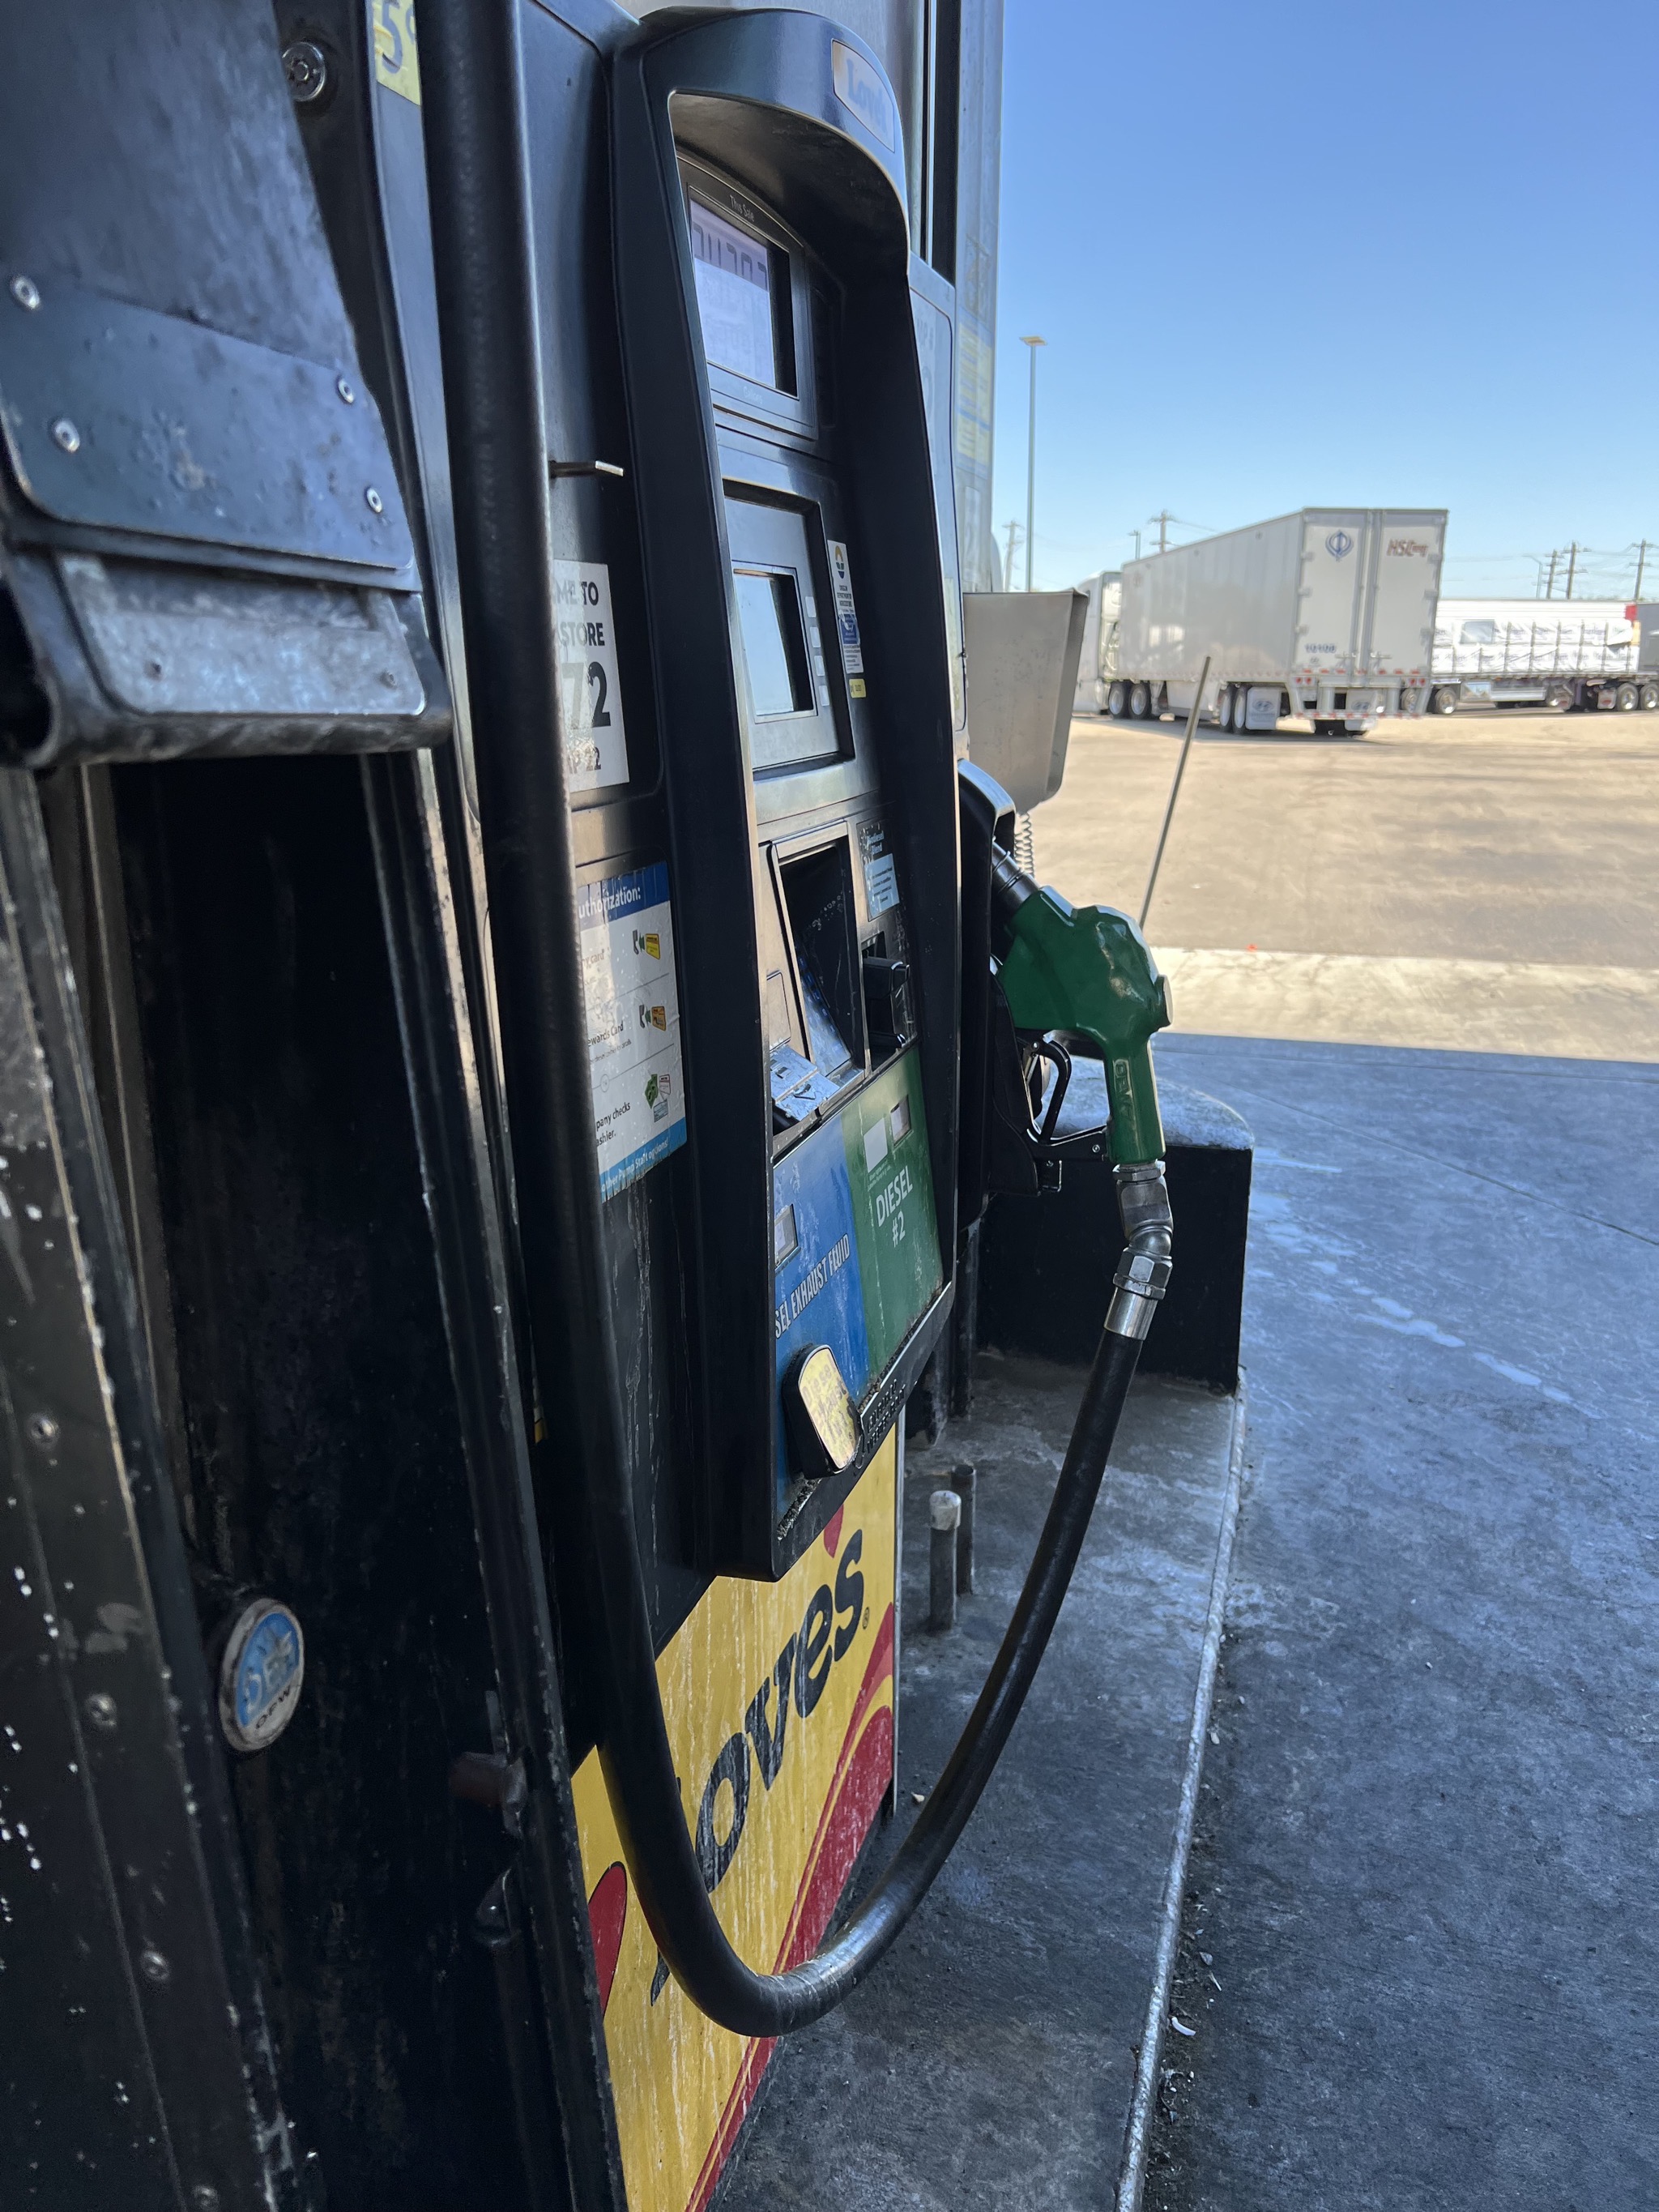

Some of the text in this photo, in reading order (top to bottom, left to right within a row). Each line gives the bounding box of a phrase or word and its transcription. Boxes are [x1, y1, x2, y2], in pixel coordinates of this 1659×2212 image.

[730, 194, 755, 223] This Sale
[580, 581, 599, 606] TO
[559, 621, 606, 647] STORE
[561, 661, 612, 729] 72
[578, 886, 642, 920] uthorization:
[588, 1020, 624, 1047] ewards Card
[595, 1102, 631, 1132] pany checks
[596, 1129, 616, 1146] ashier.
[601, 1174, 619, 1193] other
[618, 1163, 635, 1182] Pump
[876, 1165, 913, 1228] DIESEL
[892, 1211, 906, 1248] #2
[775, 1233, 851, 1339] SEL EXHAUST FLUID
[255, 1685, 292, 1730] OPW
[694, 1529, 865, 1894] oves
